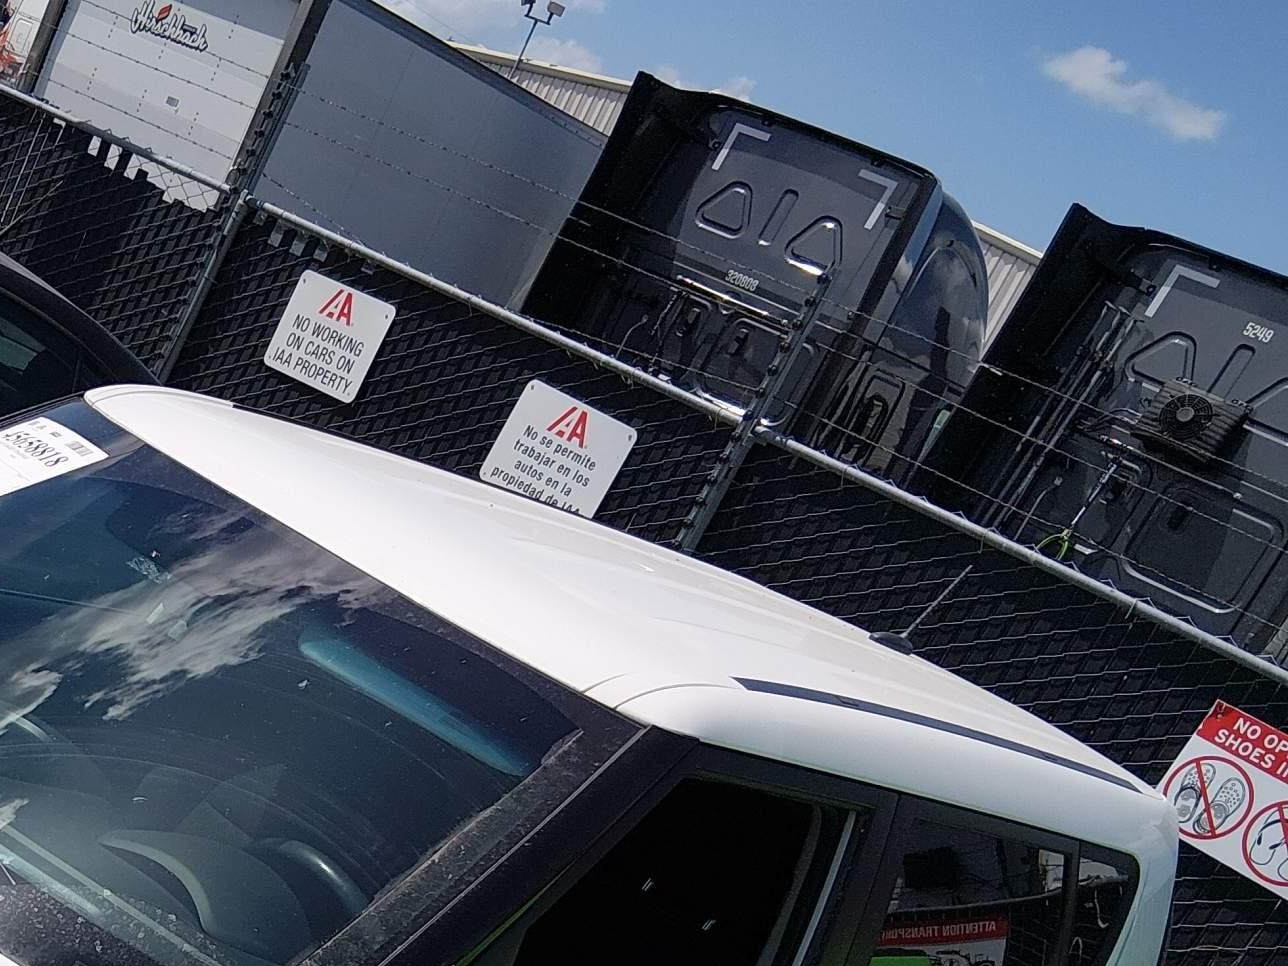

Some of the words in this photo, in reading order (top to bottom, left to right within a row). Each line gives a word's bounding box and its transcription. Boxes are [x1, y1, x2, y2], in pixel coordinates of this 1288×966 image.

[725, 269, 760, 291] 320808
[292, 314, 311, 333] NO
[312, 322, 364, 358] WORKING
[1242, 322, 1275, 343] 5249
[272, 347, 294, 369] IAA
[293, 357, 352, 394] PROPERTY
[286, 332, 305, 352] ON
[304, 340, 336, 366] CARS
[336, 355, 356, 375] ON
[513, 439, 557, 469] trabajar
[556, 464, 572, 478] en
[571, 468, 591, 488] los
[523, 425, 538, 441] No
[539, 435, 554, 449] se
[553, 443, 597, 472] permite
[490, 466, 545, 501] propiedad
[544, 494, 559, 507] de
[514, 460, 544, 481] autos
[545, 477, 560, 490] en
[560, 482, 573, 497] la
[1214, 728, 1276, 769] SHOES
[1233, 717, 1262, 740] NO
